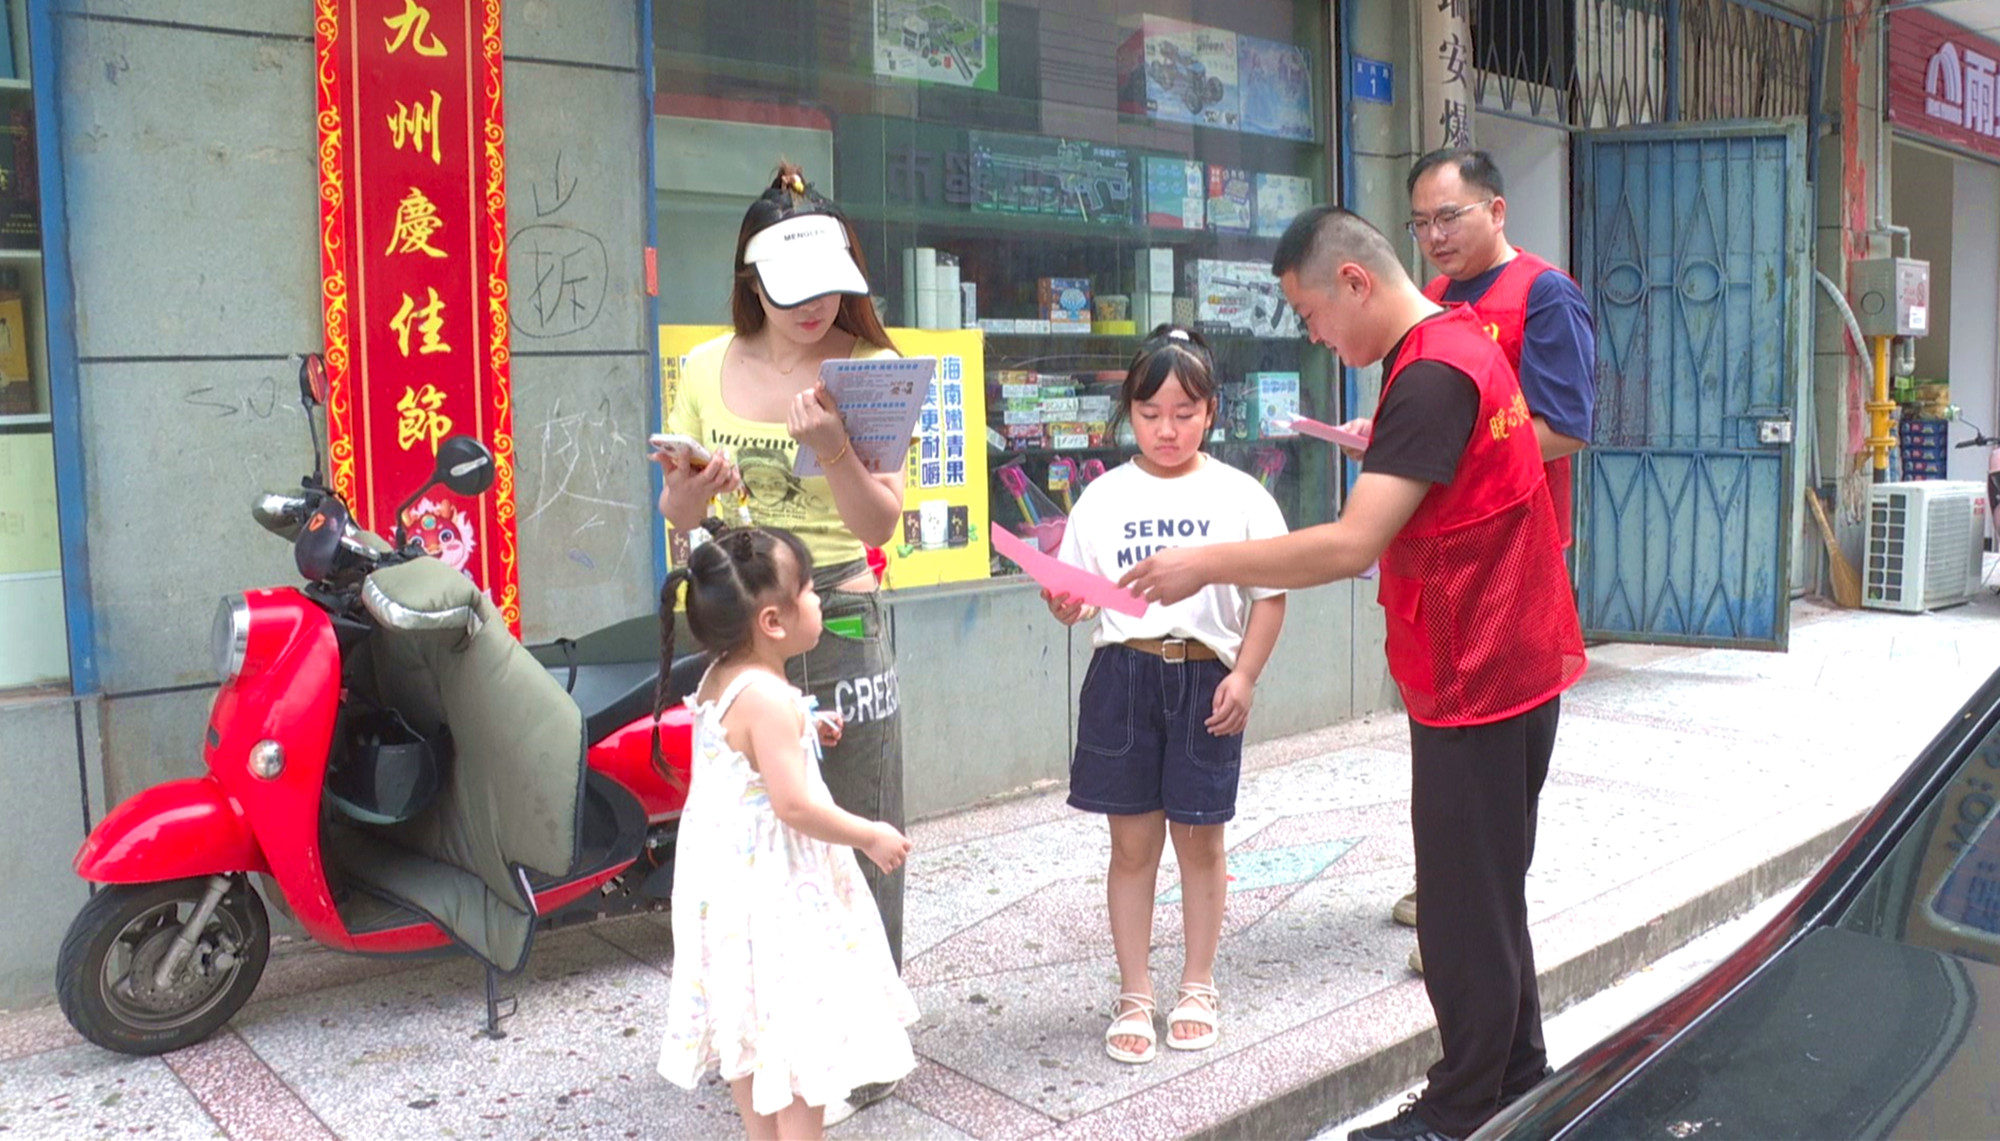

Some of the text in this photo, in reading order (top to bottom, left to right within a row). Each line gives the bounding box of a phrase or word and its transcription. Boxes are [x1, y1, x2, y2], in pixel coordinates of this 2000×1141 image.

[1370, 78, 1377, 96] 1
[1964, 48, 2000, 139] 雨
[383, 0, 453, 458] 九州慶佳節
[921, 367, 941, 488] 美更耐嚼
[943, 356, 965, 485] 海南嫩青果
[1124, 519, 1211, 539] SENOY
